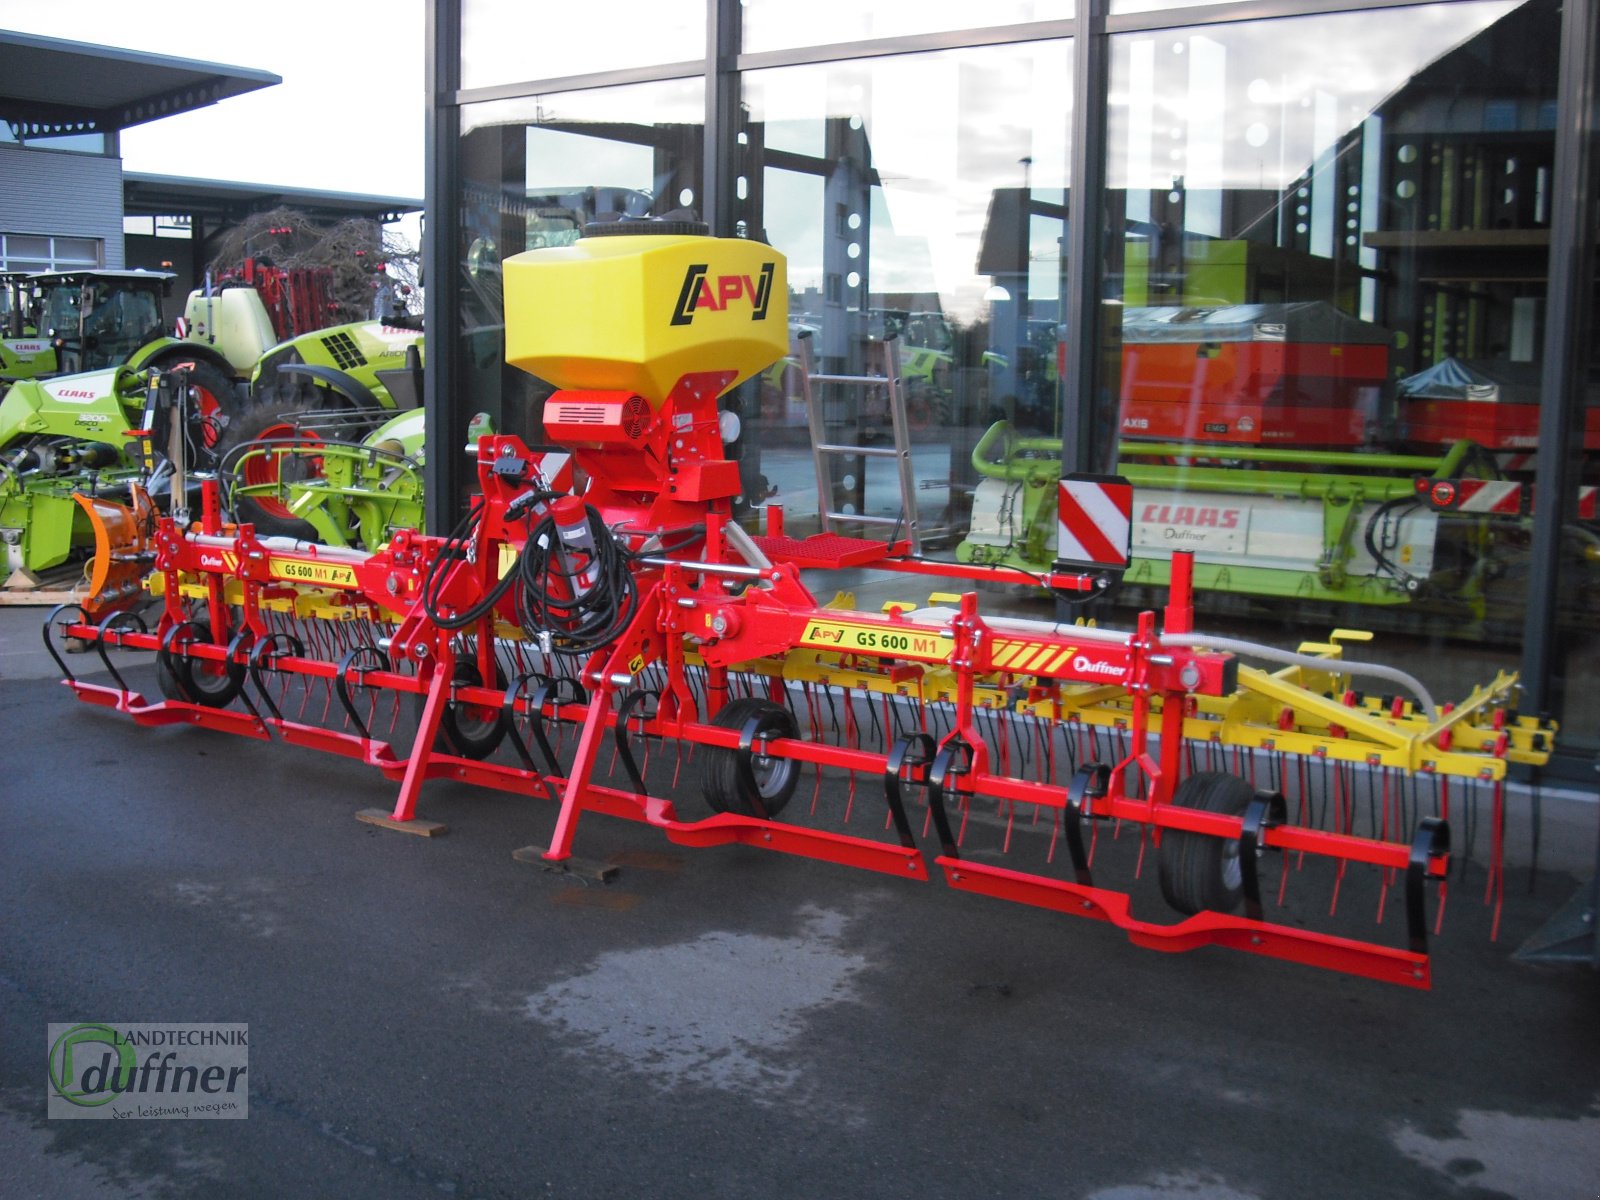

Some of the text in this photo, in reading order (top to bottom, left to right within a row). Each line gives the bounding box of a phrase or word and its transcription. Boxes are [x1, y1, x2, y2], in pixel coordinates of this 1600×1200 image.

[58, 390, 95, 398] CLAAS
[1123, 418, 1148, 429] AXIS
[1141, 504, 1240, 528] CLAAS
[285, 564, 296, 576] GS
[297, 566, 313, 578] 600
[314, 567, 328, 580] M1
[856, 632, 876, 647] GS
[881, 634, 908, 650] 600
[913, 638, 937, 653] M1
[1073, 655, 1126, 676] Duffner
